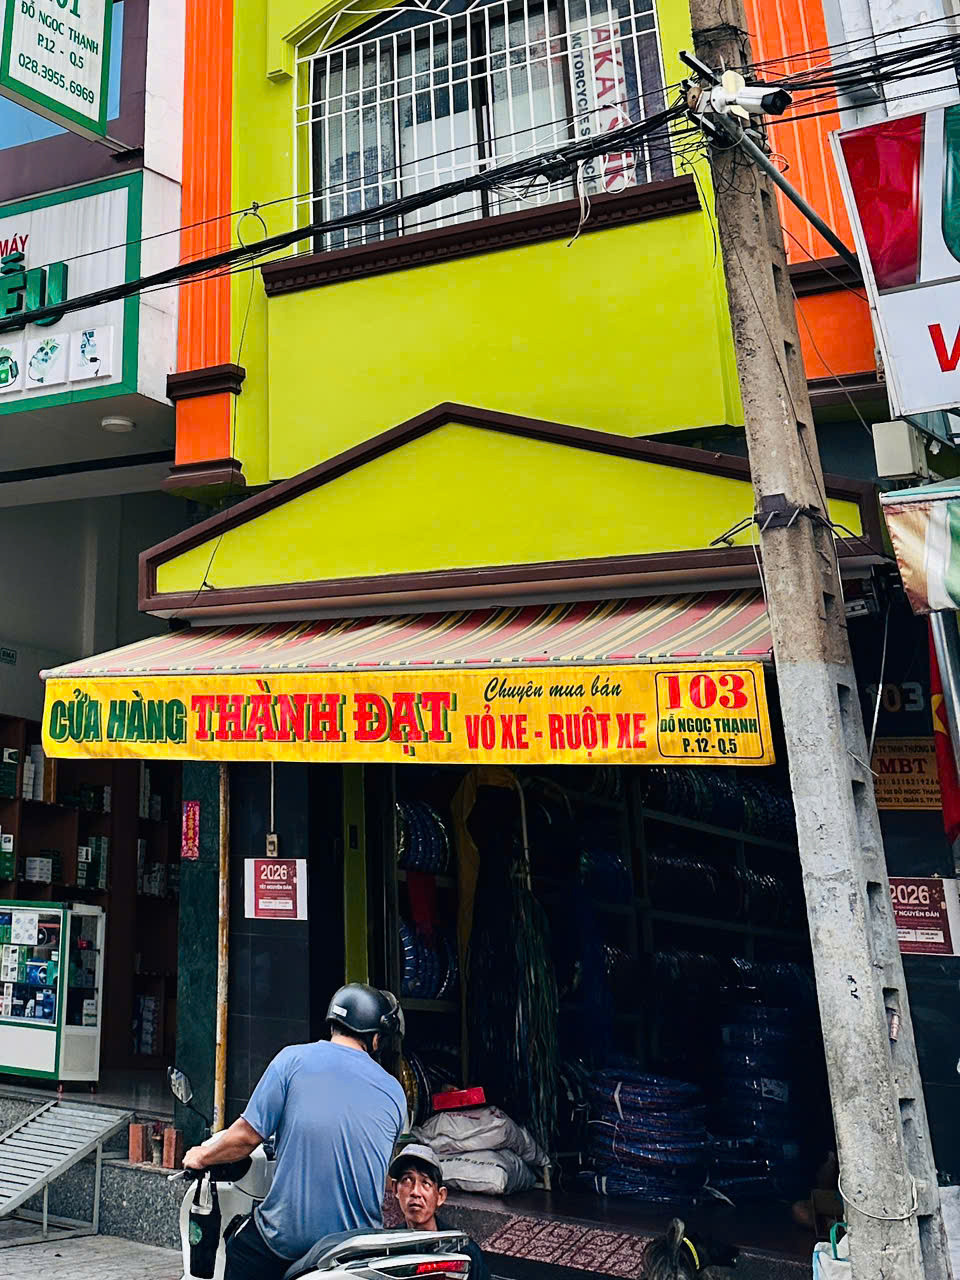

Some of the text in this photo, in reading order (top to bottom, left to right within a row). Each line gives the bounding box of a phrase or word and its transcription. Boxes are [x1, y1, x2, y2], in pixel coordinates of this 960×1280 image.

[21, 0, 99, 55] ĐỖ NGỌC THẠNH
[19, 53, 94, 104] 028.3955.6969
[484, 675, 622, 704] Chuyên mua bán
[664, 674, 748, 709] 103
[49, 679, 457, 757] CỬA HÀNG THÀNH ĐẠT
[465, 704, 496, 750] VỎ
[499, 714, 529, 750] XE
[548, 706, 611, 757] RUỘT
[615, 713, 648, 750] XE
[678, 718, 712, 736] NGỌC
[713, 718, 758, 736] THẠNH
[718, 738, 737, 755] Q.5
[877, 758, 928, 774] MBT
[260, 864, 288, 880] 2026
[890, 885, 930, 904] 2026
